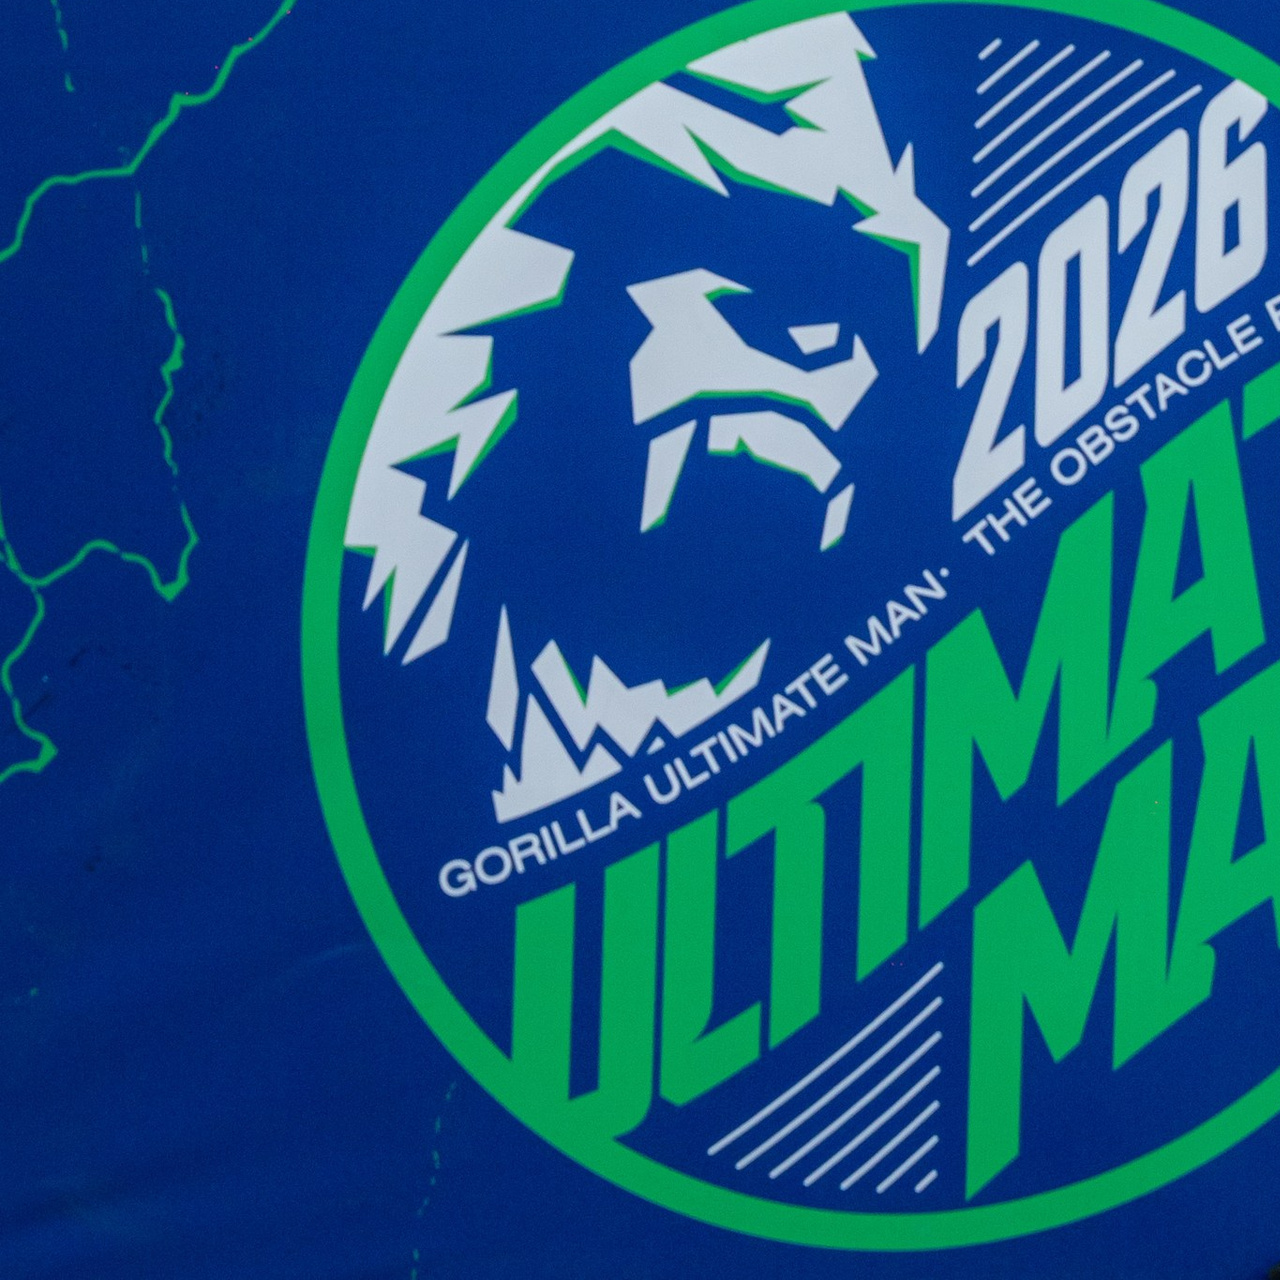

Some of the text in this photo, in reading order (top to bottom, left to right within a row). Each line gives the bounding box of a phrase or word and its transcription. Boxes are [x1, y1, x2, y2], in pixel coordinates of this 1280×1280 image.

[952, 78, 1268, 522] 2026
[438, 790, 642, 897] GORILLA
[643, 653, 849, 805] ULTIMATE
[962, 478, 1052, 556] THE
[1050, 313, 1263, 486] OBSTACLE
